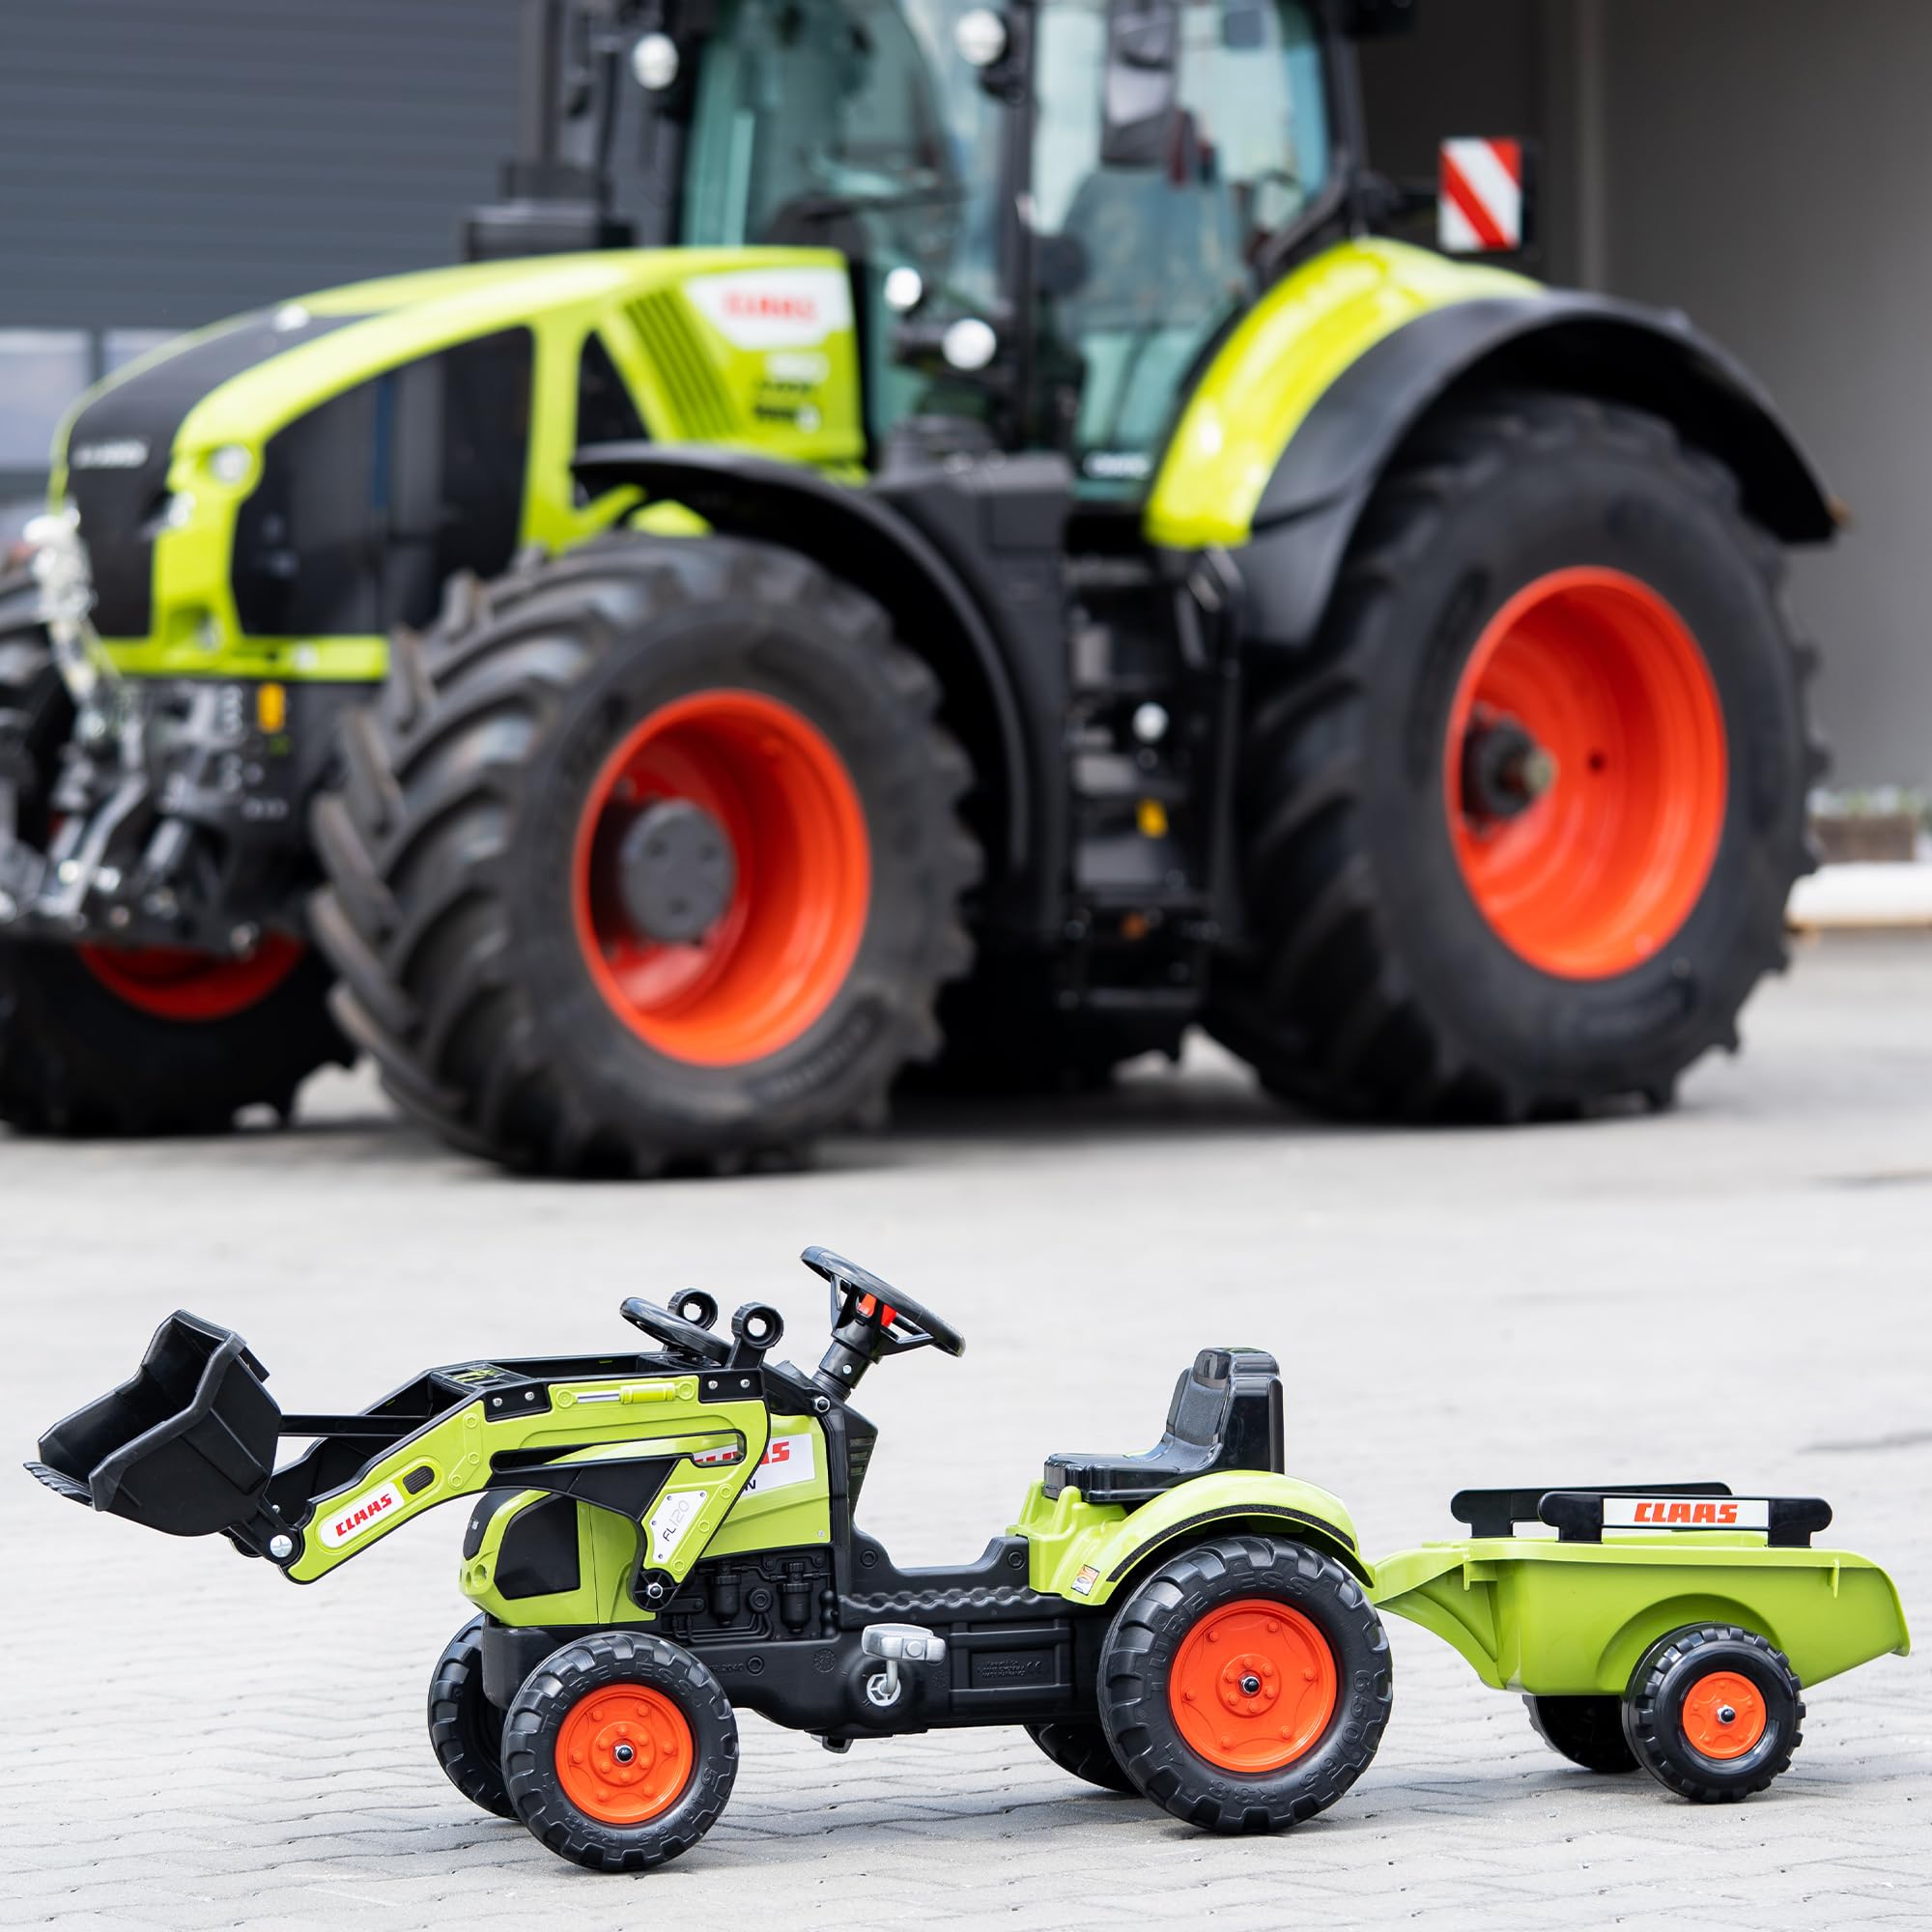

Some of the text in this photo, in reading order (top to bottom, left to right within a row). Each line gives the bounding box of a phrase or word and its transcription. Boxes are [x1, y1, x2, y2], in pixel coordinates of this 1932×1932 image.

[335, 1493, 392, 1537] CLAAS
[1634, 1502, 1738, 1523] CLAAS
[1147, 1571, 1312, 1700] TUBELESS
[541, 1662, 692, 1733] TUBELESS
